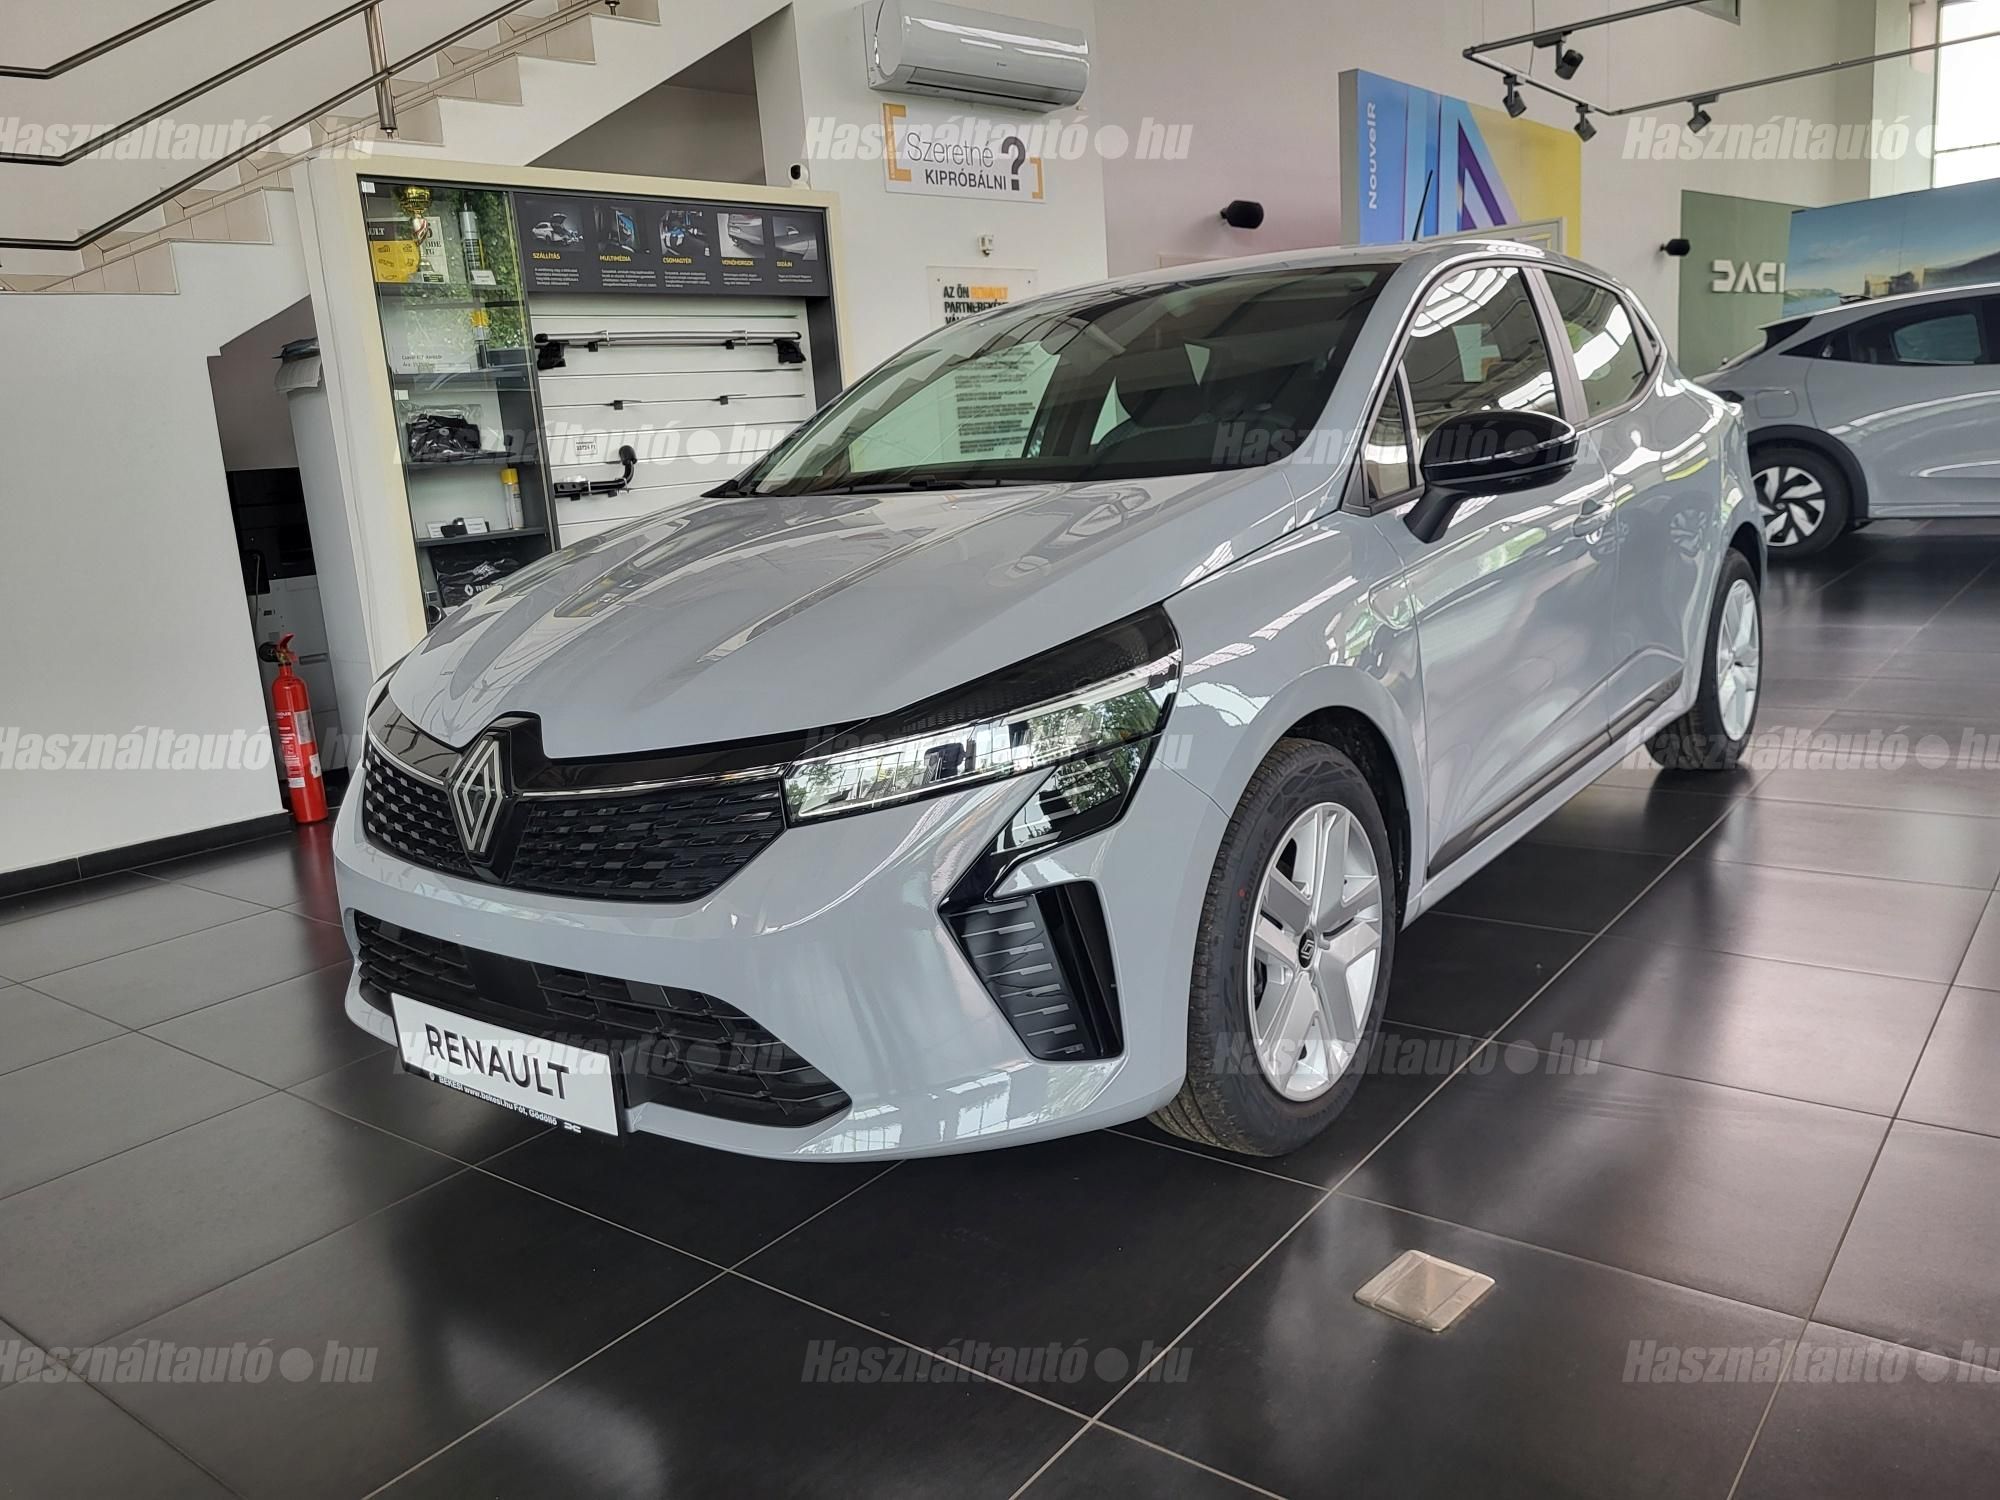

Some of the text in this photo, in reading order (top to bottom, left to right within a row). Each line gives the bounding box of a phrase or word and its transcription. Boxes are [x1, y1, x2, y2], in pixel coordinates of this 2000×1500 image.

[906, 132, 994, 168] Szeretné
[925, 136, 1026, 191] KIPRÓBÁLNI ?
[943, 286, 955, 299] AZ
[957, 283, 969, 299] ÖN
[425, 1024, 569, 1099] RENAULT
[464, 1086, 513, 1111] www.bekesi.hu
